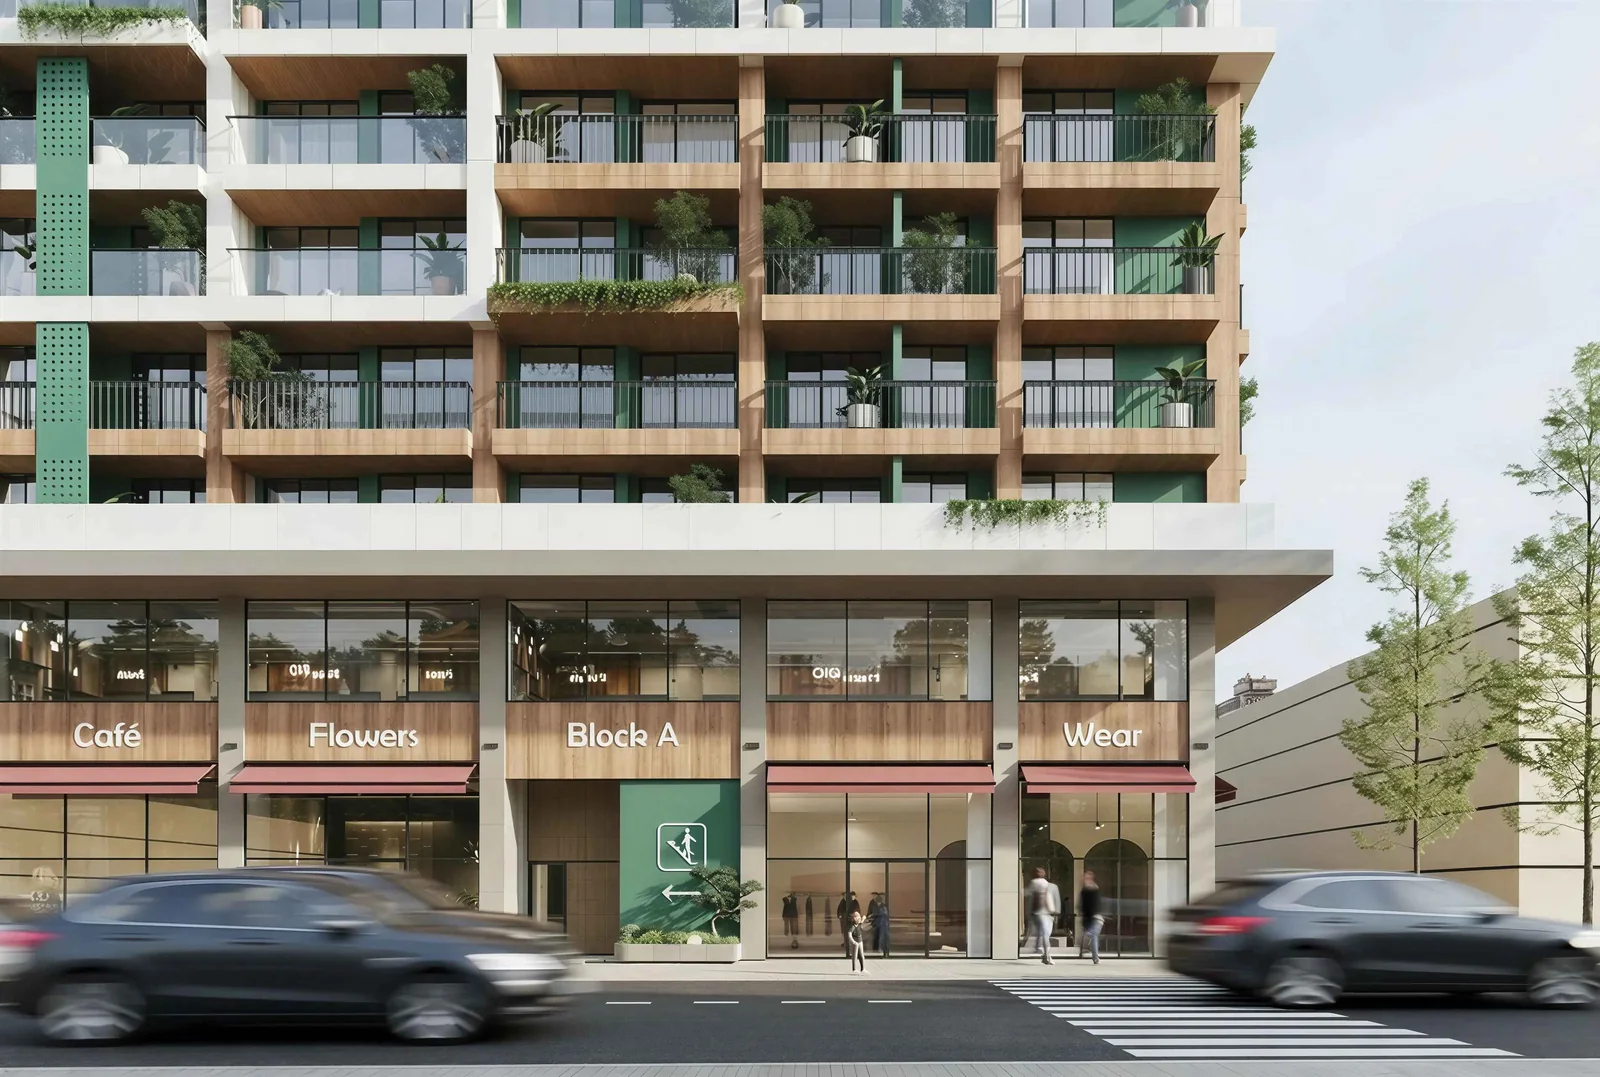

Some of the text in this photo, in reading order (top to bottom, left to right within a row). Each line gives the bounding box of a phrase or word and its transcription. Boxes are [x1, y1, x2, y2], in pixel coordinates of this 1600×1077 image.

[73, 722, 142, 748] Café
[309, 722, 420, 749] Flowers
[567, 721, 680, 748] Block A
[1063, 721, 1143, 748] Wear
